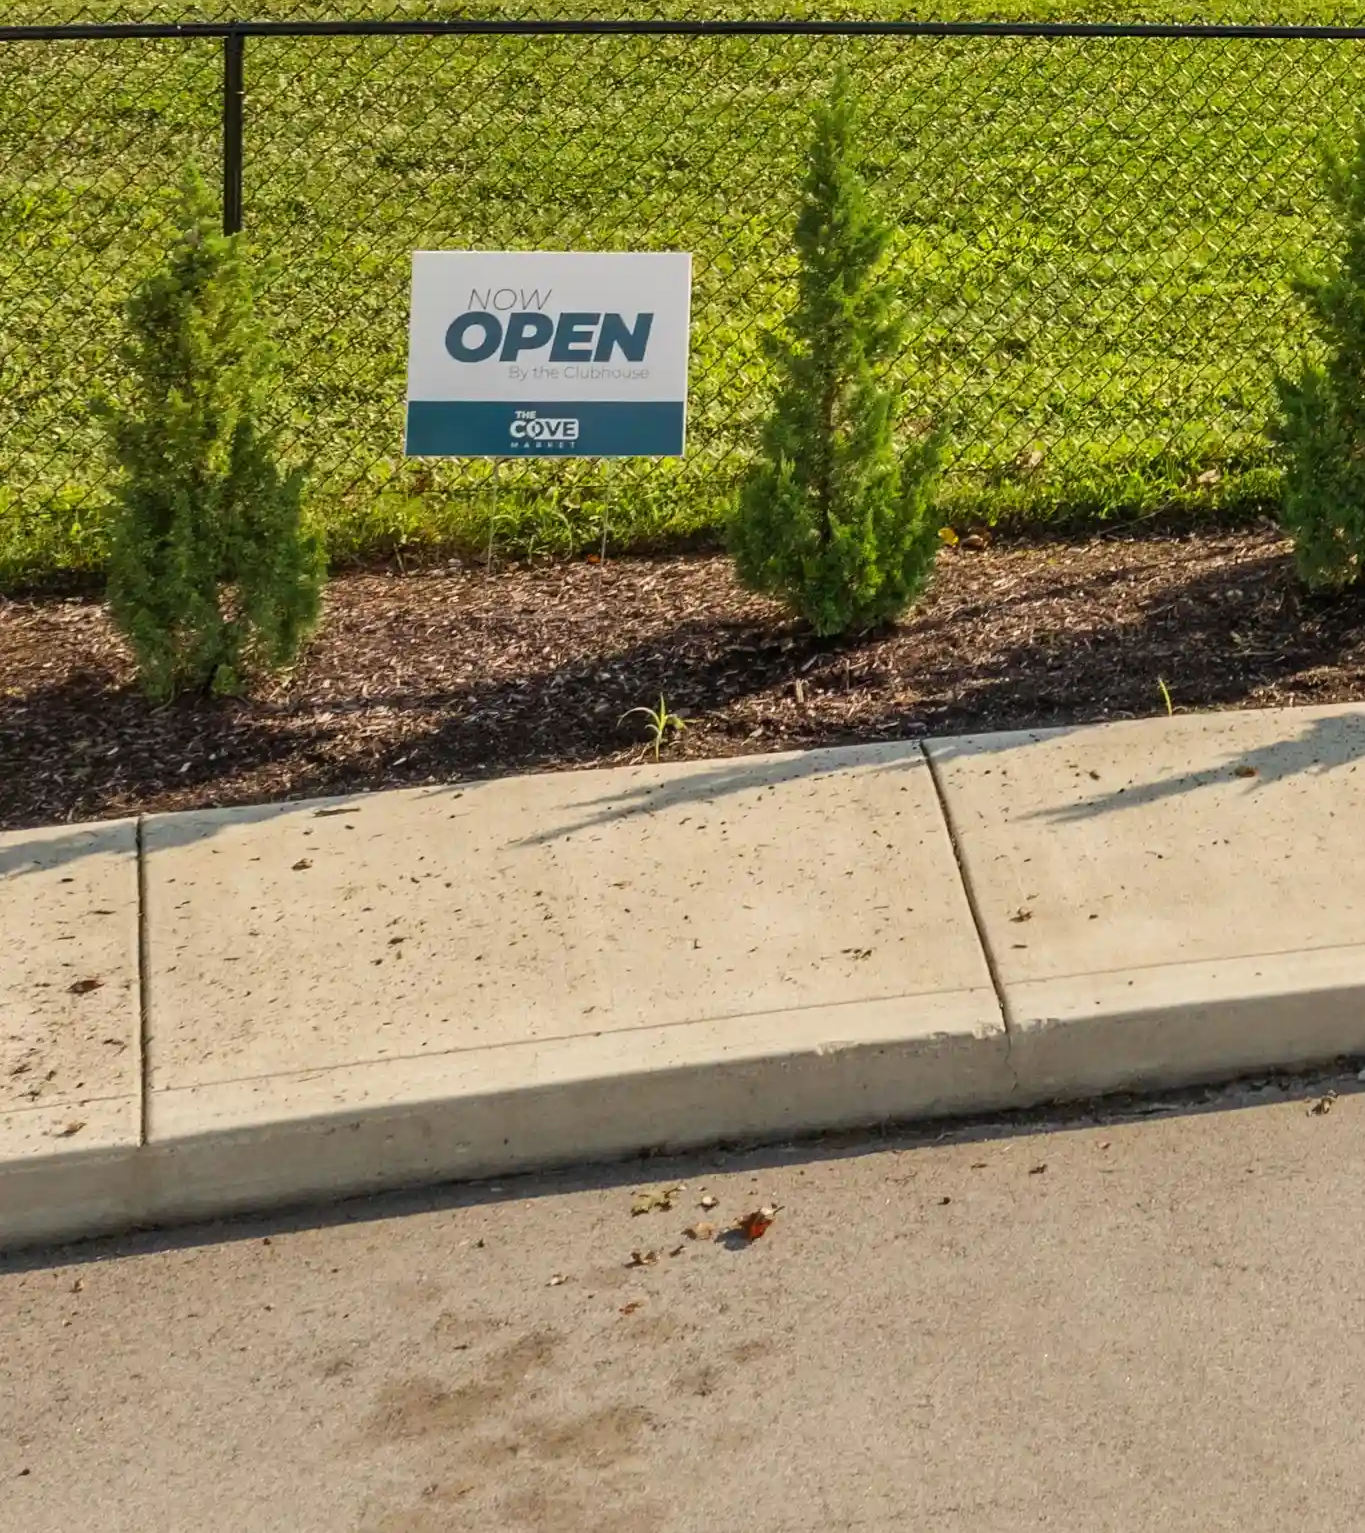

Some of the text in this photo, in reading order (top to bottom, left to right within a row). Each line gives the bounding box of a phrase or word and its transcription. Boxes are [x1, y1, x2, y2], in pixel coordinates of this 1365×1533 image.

[468, 288, 552, 311] NOW
[445, 311, 654, 363] OPEN
[508, 365, 650, 381] By the Clubhouse
[515, 410, 536, 419] THE
[510, 419, 577, 439] COVE
